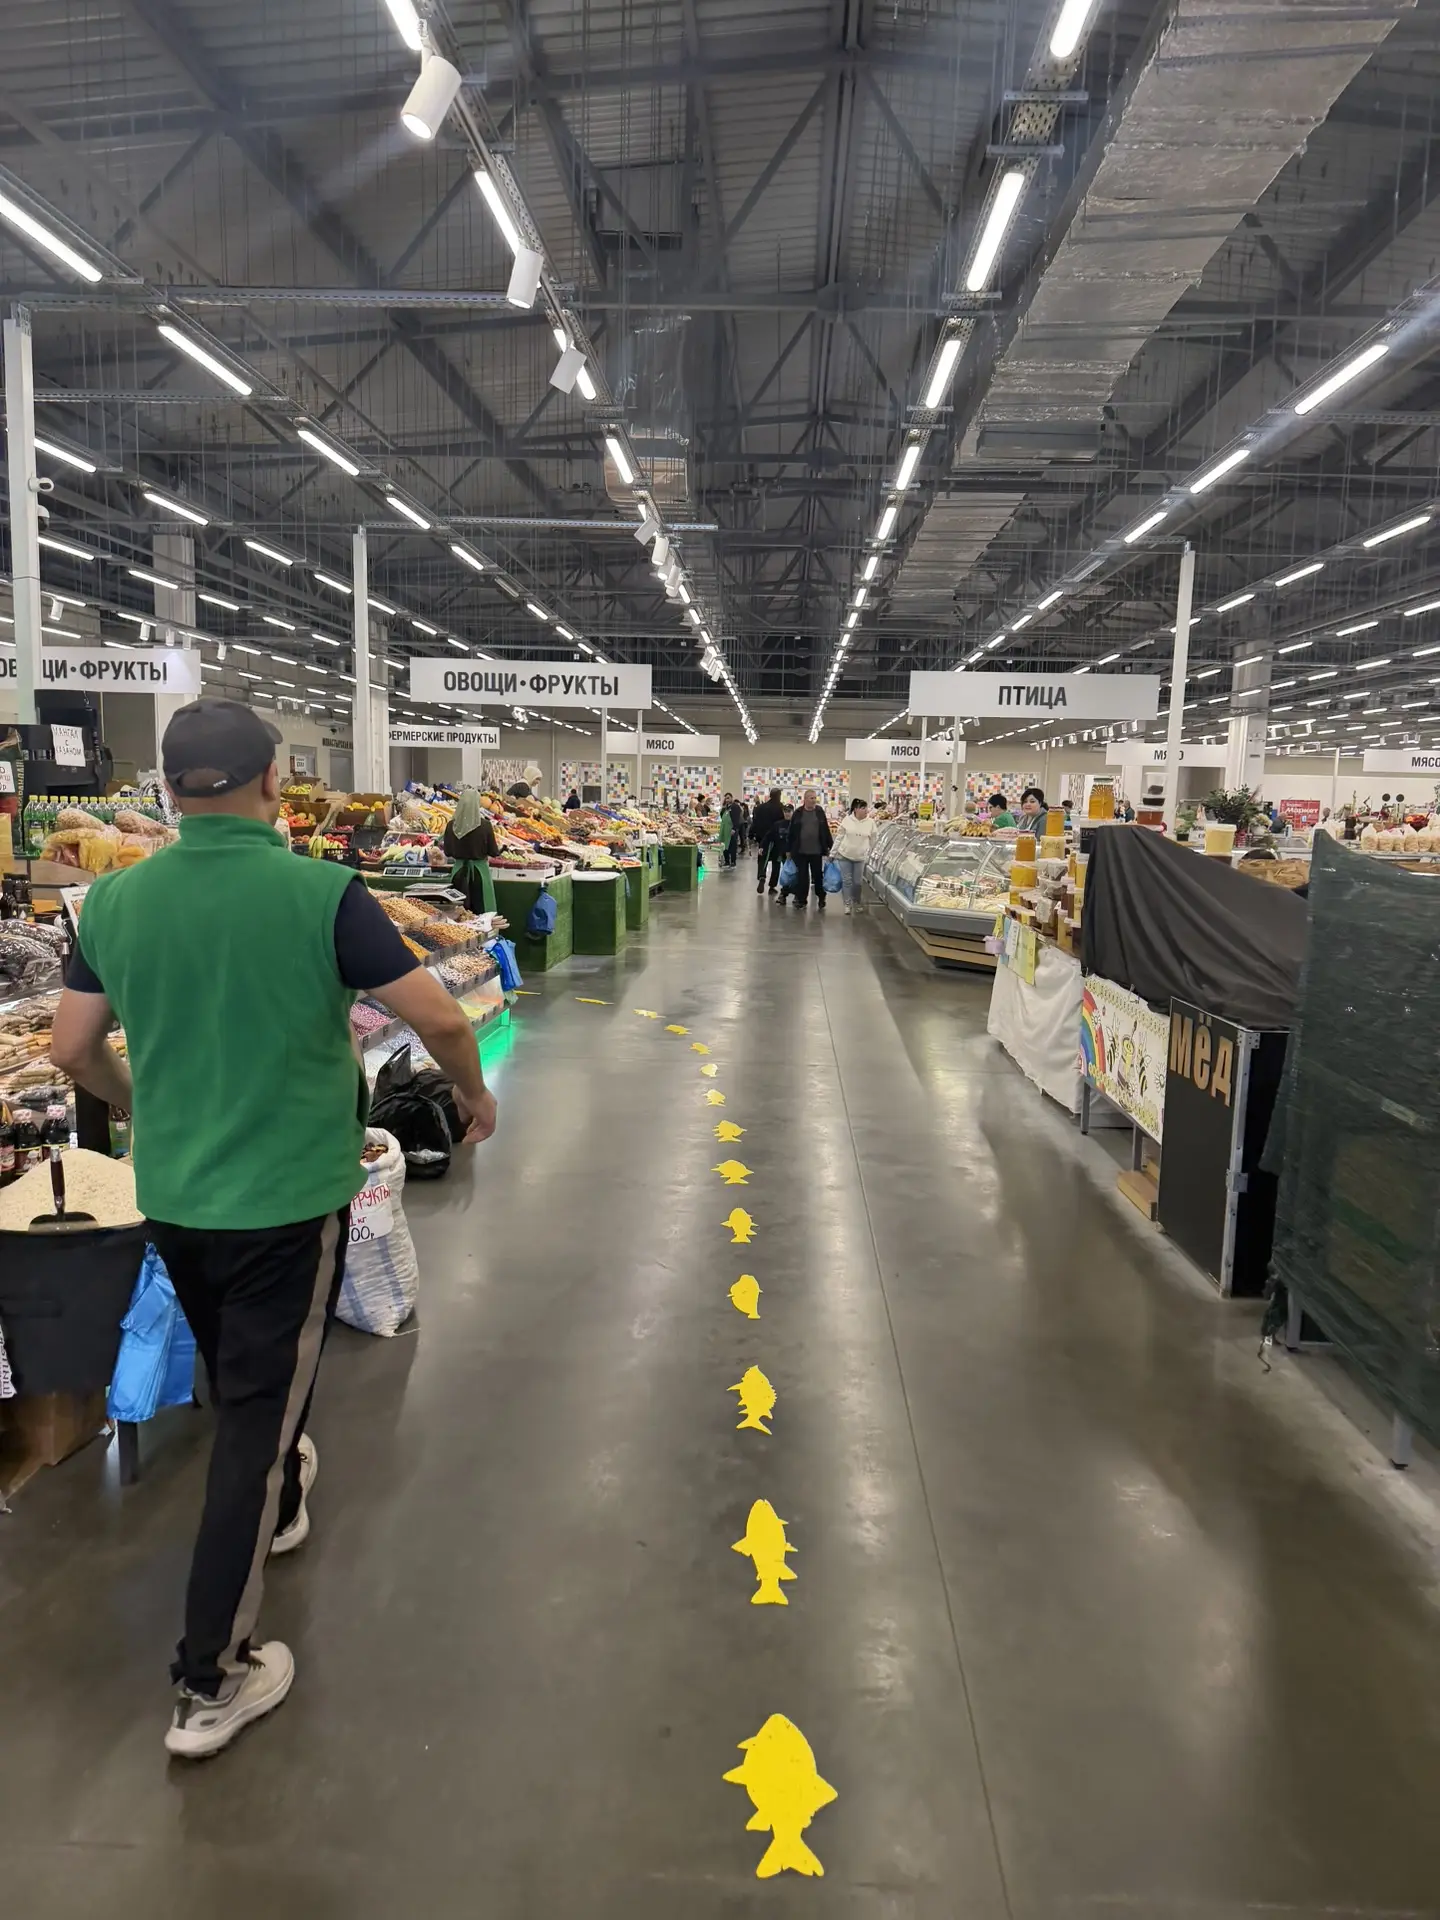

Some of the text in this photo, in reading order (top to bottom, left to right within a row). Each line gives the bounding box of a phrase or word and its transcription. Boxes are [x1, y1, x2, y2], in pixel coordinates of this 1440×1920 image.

[998, 685, 1067, 710] ПТИЦА
[446, 732, 497, 744] ПРОДУКТЫ
[646, 739, 675, 750] МЯСО
[891, 745, 920, 756] МЯСО
